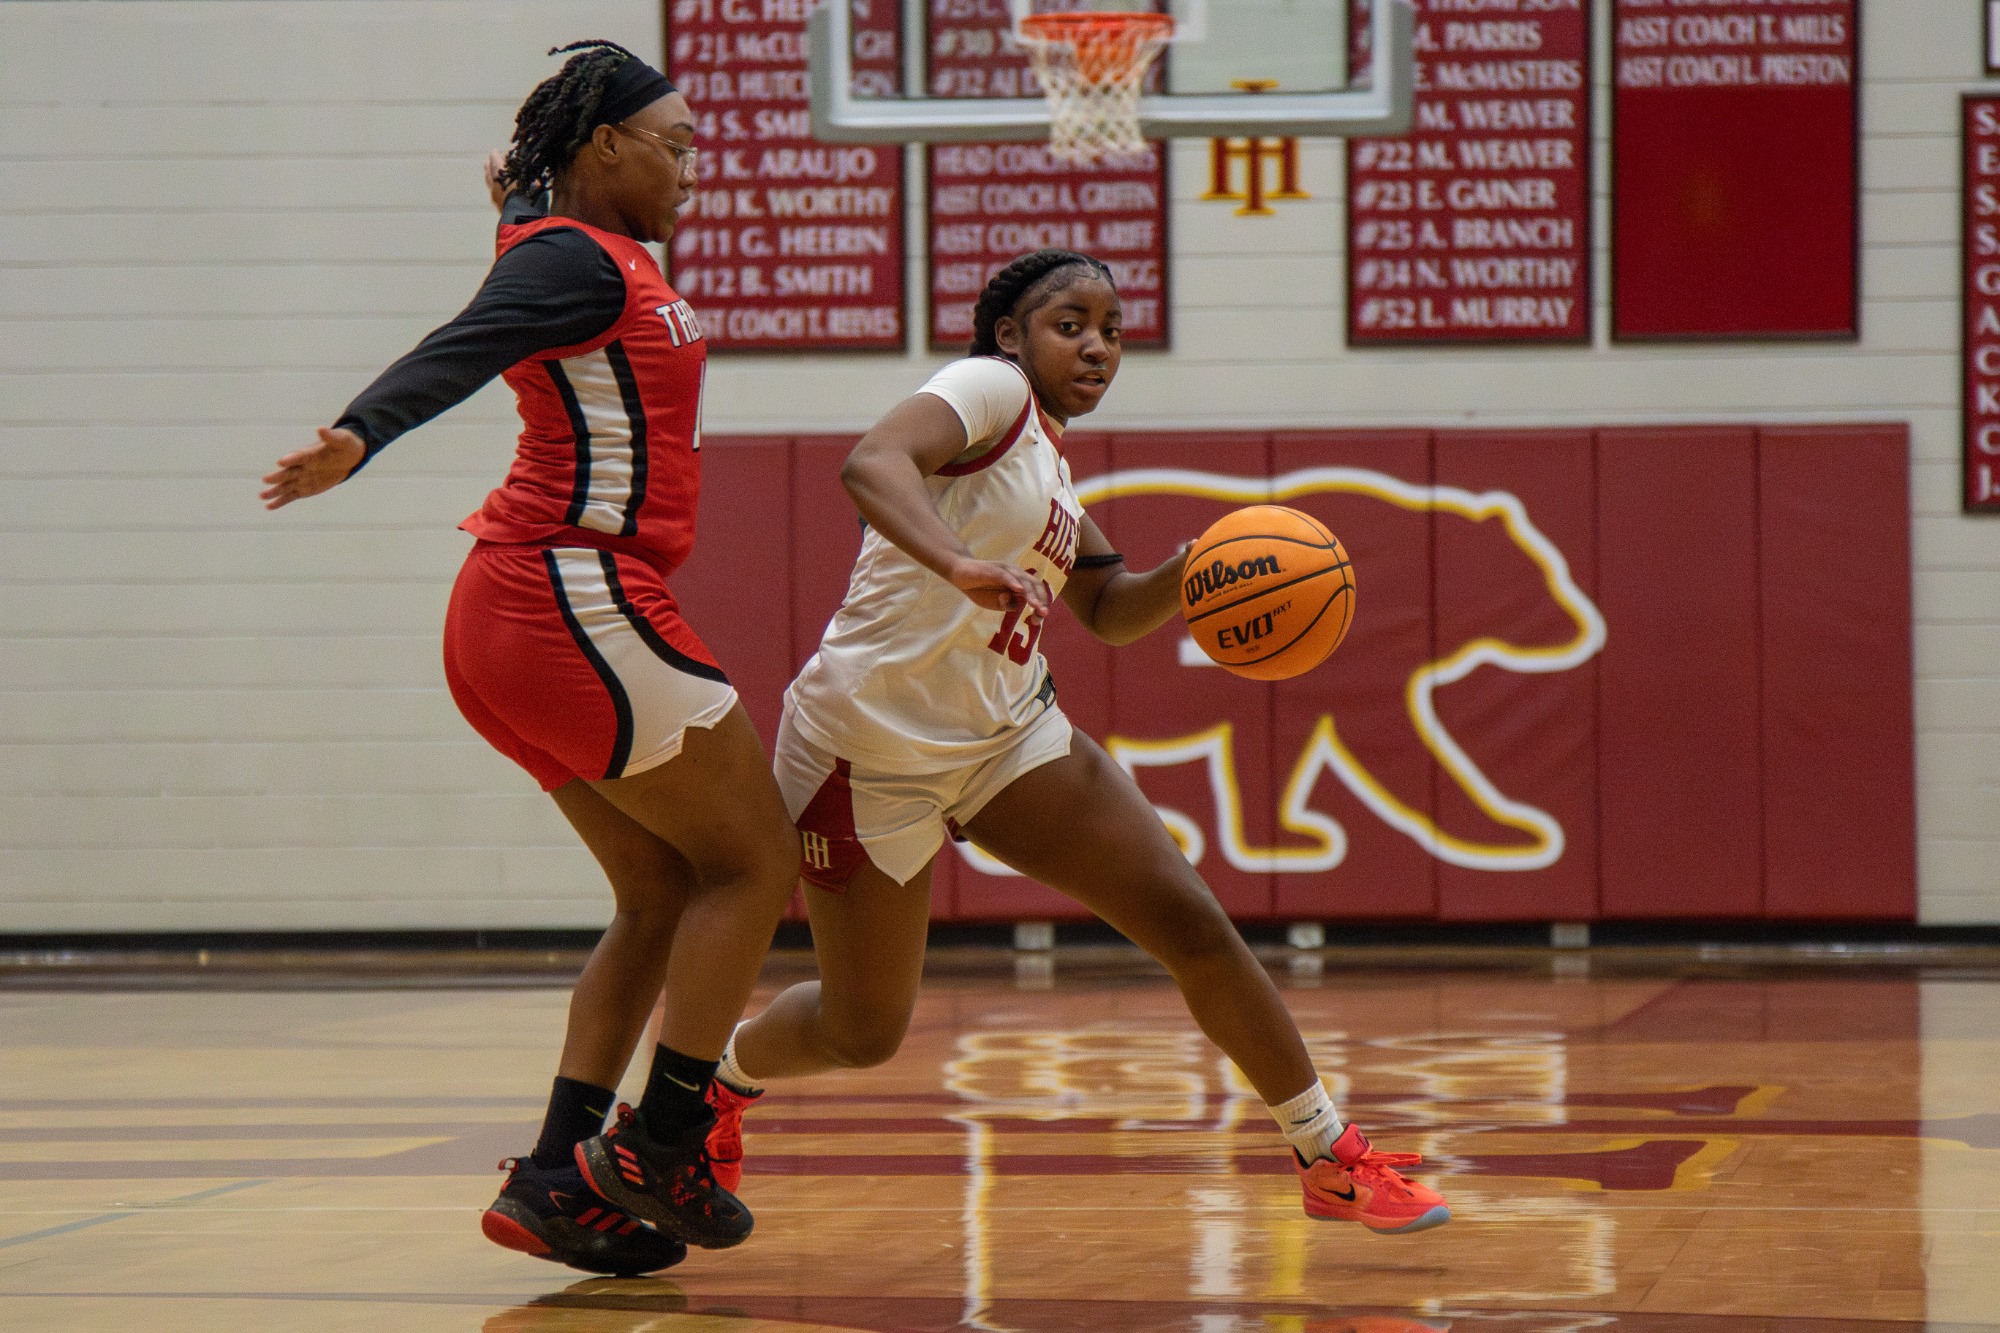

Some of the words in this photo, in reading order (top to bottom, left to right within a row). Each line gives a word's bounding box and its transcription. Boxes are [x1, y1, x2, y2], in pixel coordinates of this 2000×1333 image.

[1444, 21, 1543, 50] PARRIS
[1620, 17, 1670, 46] ASST
[1674, 15, 1756, 46] COACH
[1782, 14, 1846, 45] MILLS
[1434, 59, 1582, 91] McMASTERS
[1620, 55, 1665, 88] ASST
[1667, 54, 1740, 88] COACH
[1762, 53, 1849, 85] PRESTON
[754, 109, 811, 141] SMI
[1457, 99, 1575, 130] WEAVER
[721, 149, 753, 179] K.
[758, 147, 877, 183] ARAUJO
[1355, 140, 1414, 171] #22
[1457, 139, 1574, 171] WEAVER
[766, 186, 895, 219] WORTHY
[1447, 178, 1557, 211] GAINER
[674, 228, 732, 258] #11
[779, 225, 889, 256] HEERIN
[1452, 218, 1575, 249] BRANCH
[674, 267, 736, 298] #12
[774, 264, 873, 298] SMITH
[1450, 257, 1579, 290] WORTHY
[727, 307, 804, 341] COACH
[1451, 296, 1576, 329] MURRAY
[1184, 554, 1281, 607] Wilson
[1217, 612, 1274, 649] EVO
